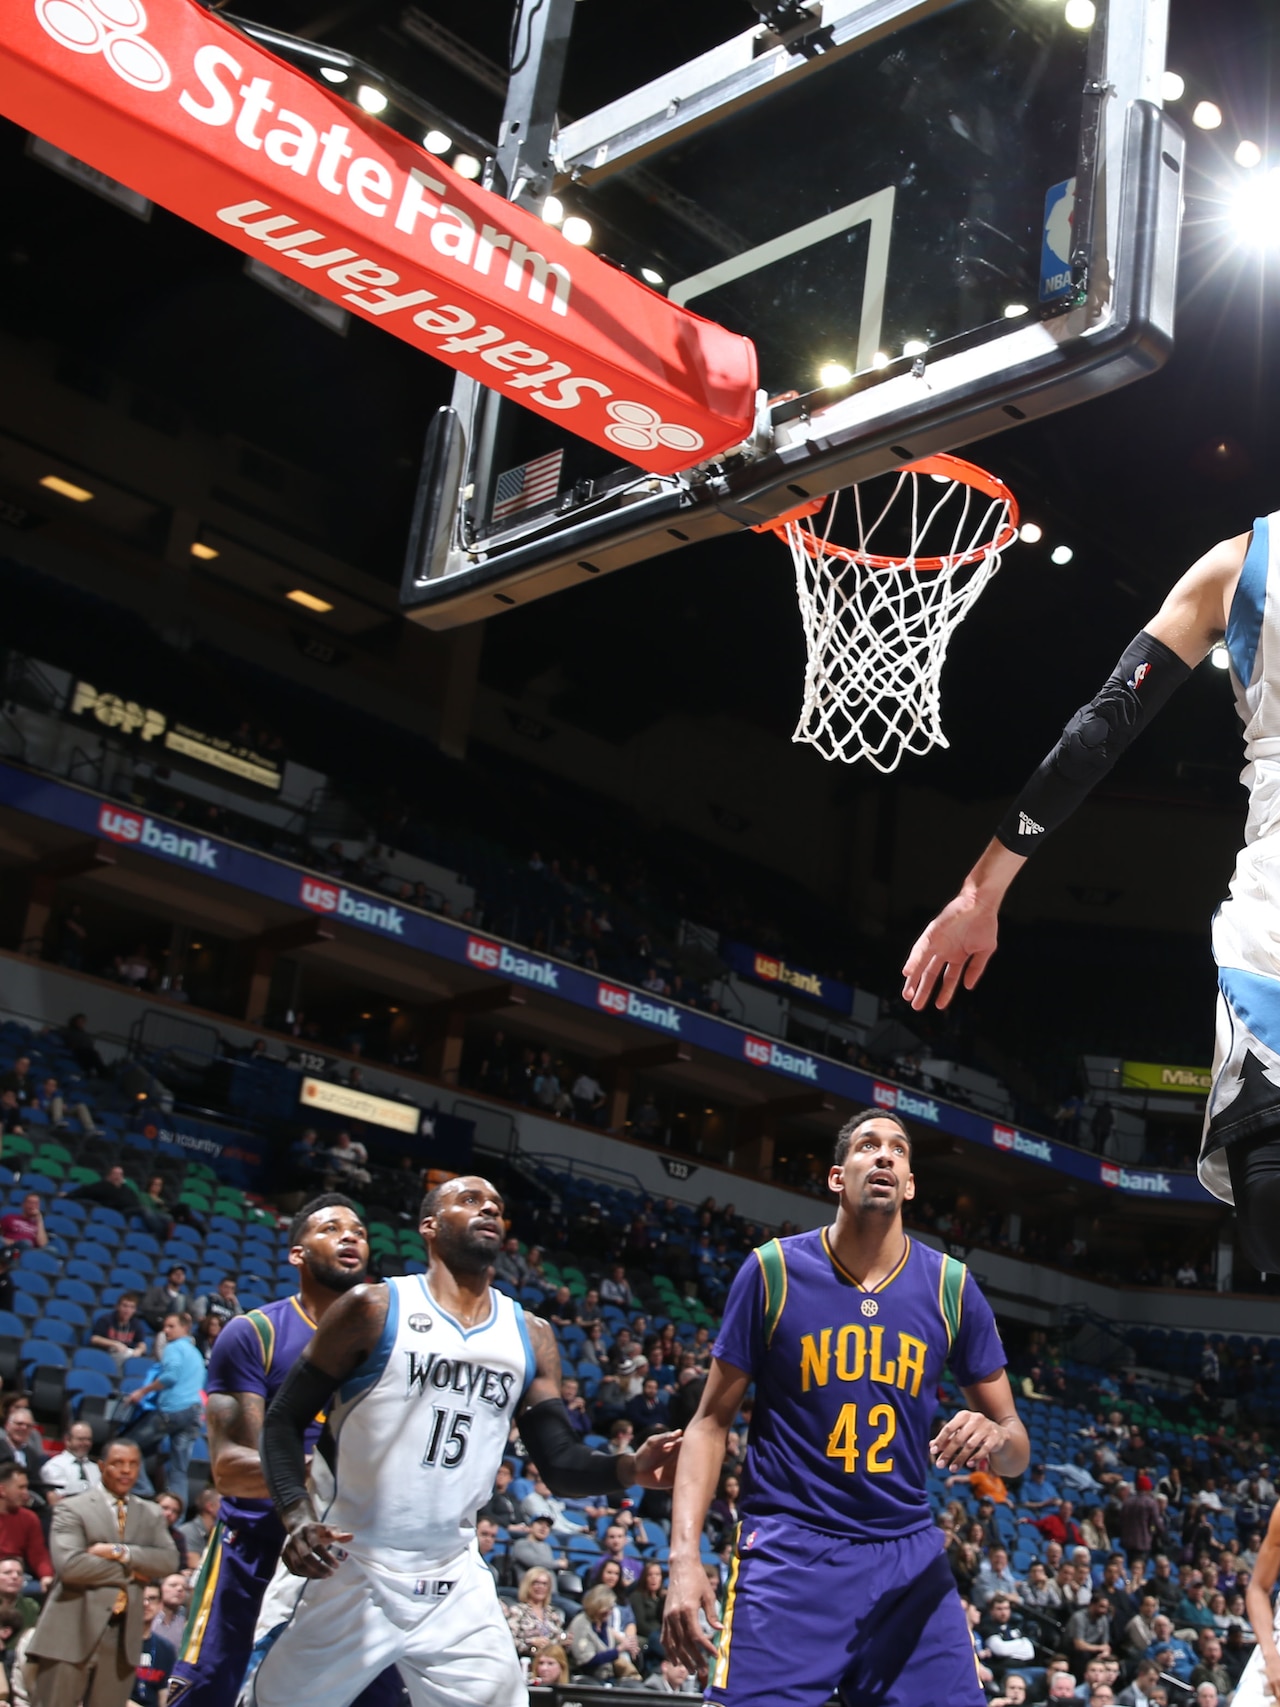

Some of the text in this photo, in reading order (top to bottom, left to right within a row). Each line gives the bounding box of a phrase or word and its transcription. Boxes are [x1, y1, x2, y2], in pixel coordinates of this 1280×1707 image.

[1045, 270, 1072, 295] NBA
[1019, 811, 1045, 832] adidas
[404, 1351, 517, 1411] WOLVES
[800, 1324, 928, 1399] NOLA
[421, 1402, 475, 1469] 15
[826, 1402, 897, 1473] 42
